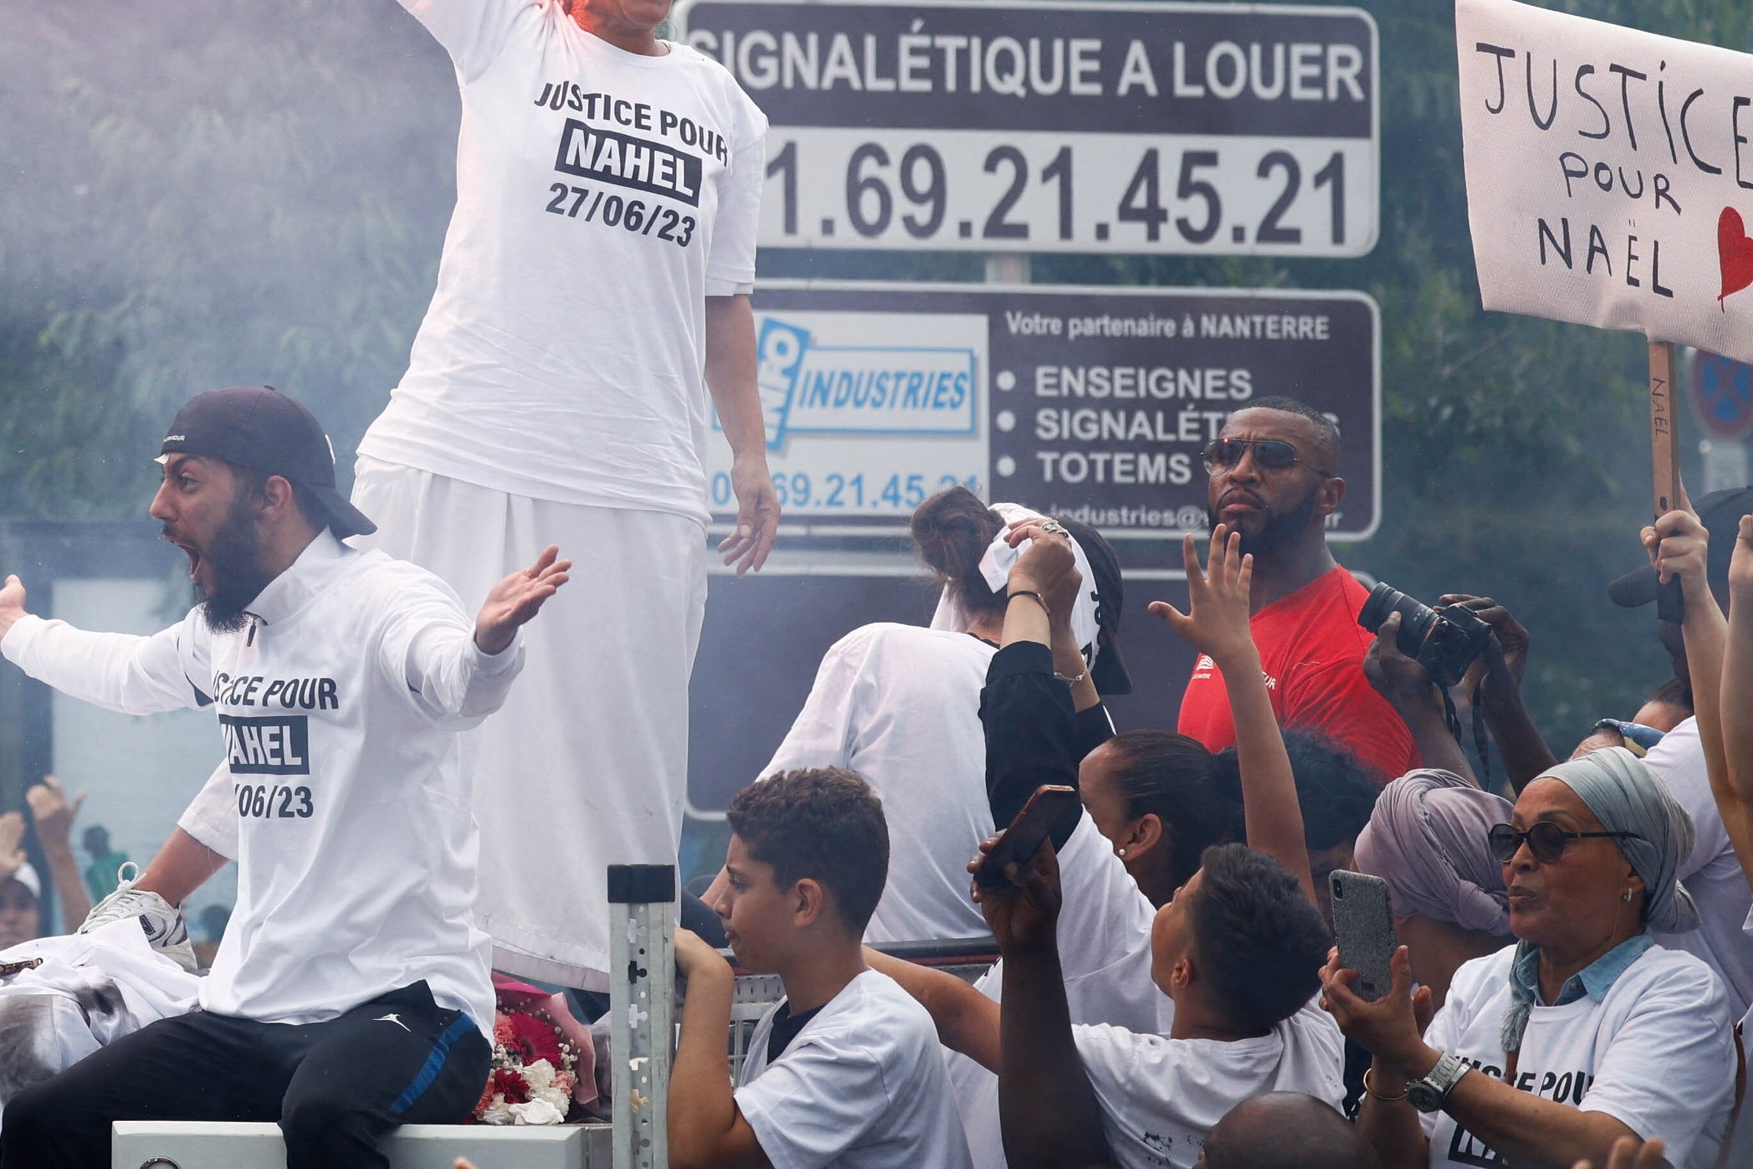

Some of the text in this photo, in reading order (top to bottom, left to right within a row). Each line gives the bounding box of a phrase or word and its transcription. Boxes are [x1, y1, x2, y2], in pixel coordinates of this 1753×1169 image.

[1117, 39, 1158, 97] A
[1173, 41, 1366, 102] LOUER
[534, 80, 728, 168] JUSTICE POUR
[564, 127, 695, 199] NAHEL
[1559, 151, 1682, 216] POUR
[545, 182, 696, 248] 27/06/23
[765, 140, 1346, 246] 1.69.21.45.21
[1538, 217, 1674, 298] NAËL
[1004, 310, 1331, 341] Votre partenaire à NANTERRE
[797, 369, 969, 410] INDUSTRIES
[1034, 365, 1254, 401] ENSEIGNES
[1035, 402, 1341, 443] SIGNALÉT
[1035, 451, 1193, 485] TOTEMS
[262, 677, 339, 710] POUR
[1538, 1070, 1595, 1107] POU
